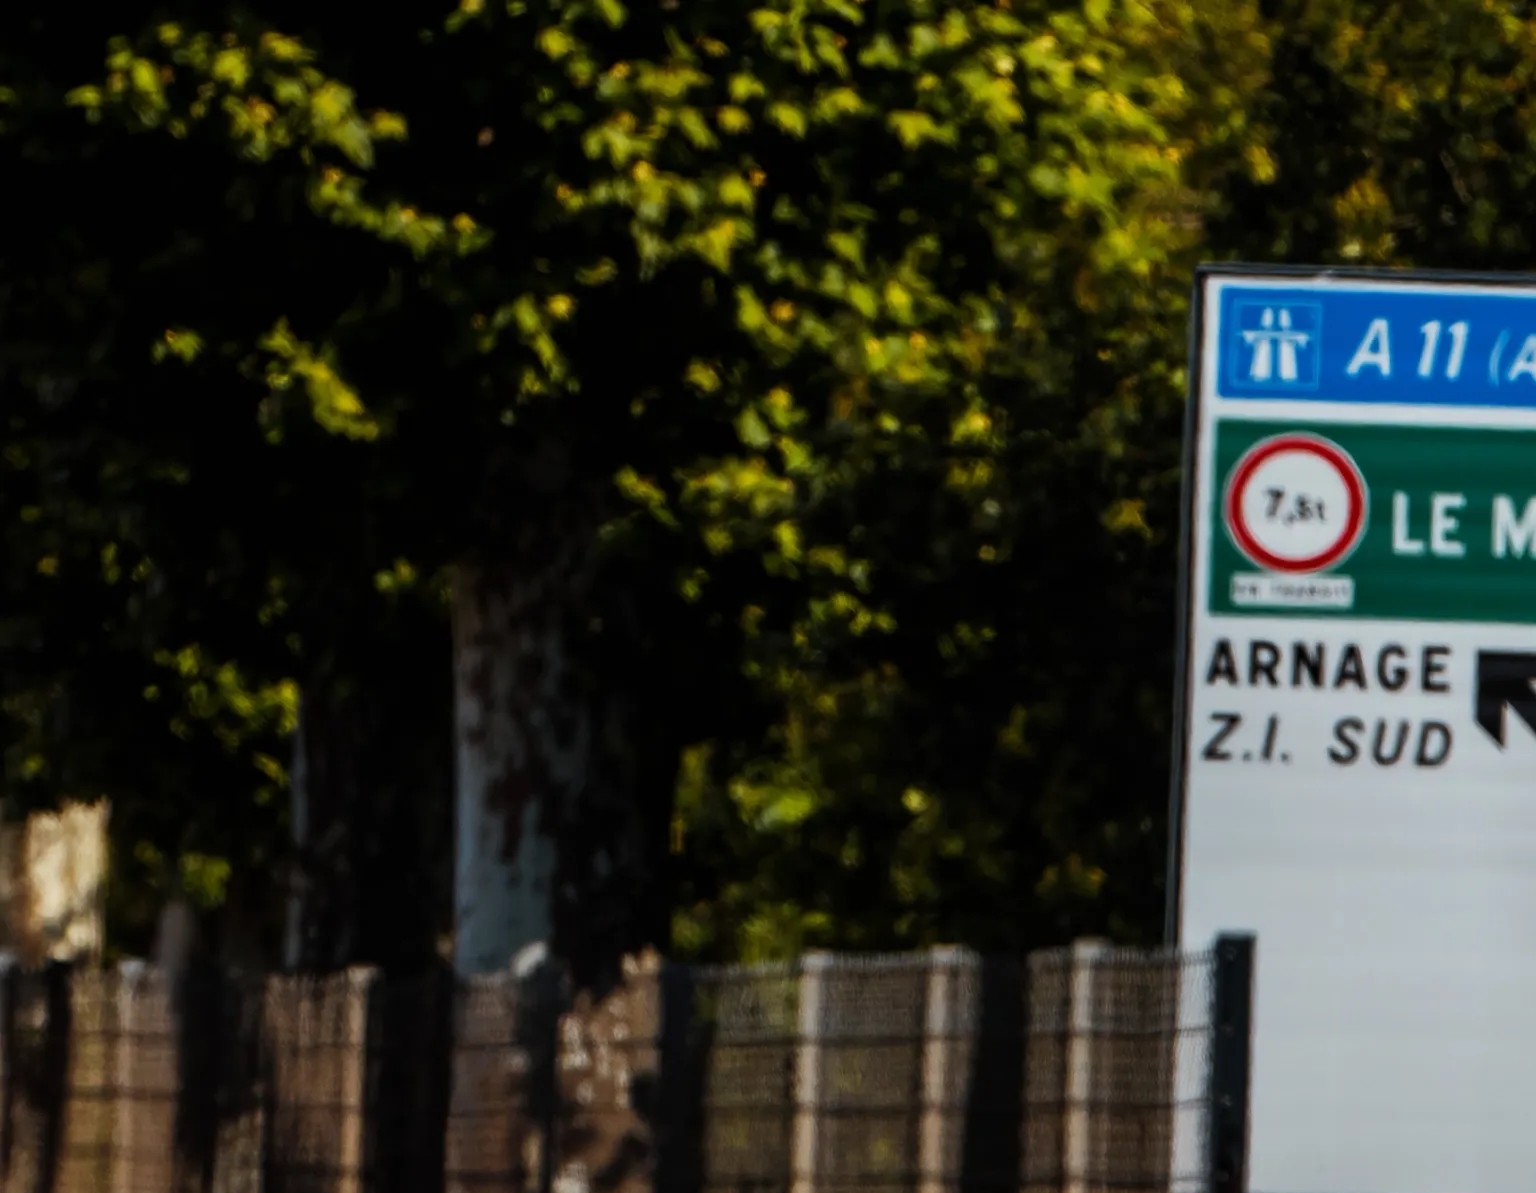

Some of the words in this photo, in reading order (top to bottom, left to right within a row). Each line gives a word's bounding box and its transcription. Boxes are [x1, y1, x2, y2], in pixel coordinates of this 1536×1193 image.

[1346, 318, 1391, 376] A
[1418, 320, 1468, 378] 11
[1391, 491, 1465, 556] LE
[1205, 638, 1451, 693] ARNAGE
[1201, 712, 1290, 763] Z.I.
[1327, 716, 1453, 768] SUD
